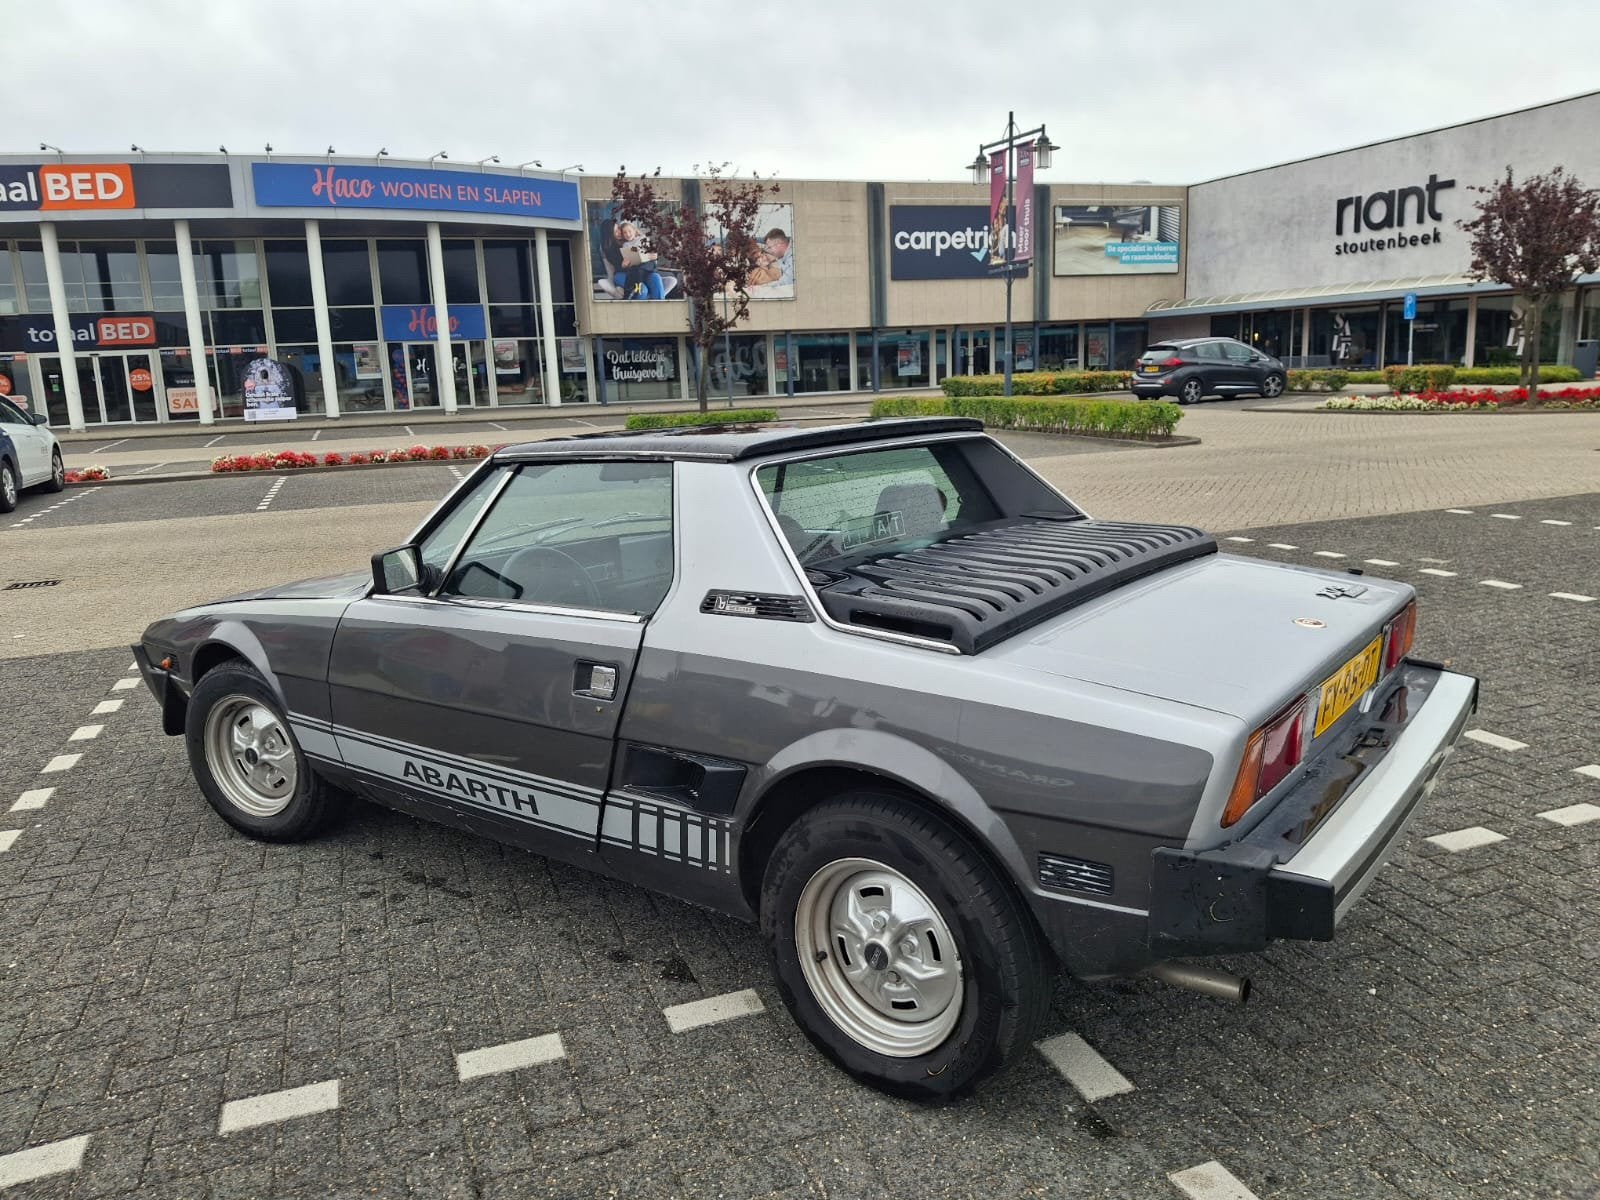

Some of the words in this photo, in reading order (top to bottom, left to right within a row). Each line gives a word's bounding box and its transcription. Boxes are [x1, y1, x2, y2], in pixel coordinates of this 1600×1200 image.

[44, 172, 124, 201] BED
[312, 167, 375, 204] Haco
[380, 181, 452, 199] WONEN
[457, 185, 480, 200] EN
[484, 186, 543, 206] SLAPEN
[1335, 174, 1455, 236] riant
[1335, 227, 1441, 256] stoutenbeek
[101, 322, 150, 341] BED
[408, 307, 460, 339] Hao
[403, 760, 540, 816] ABARTH
